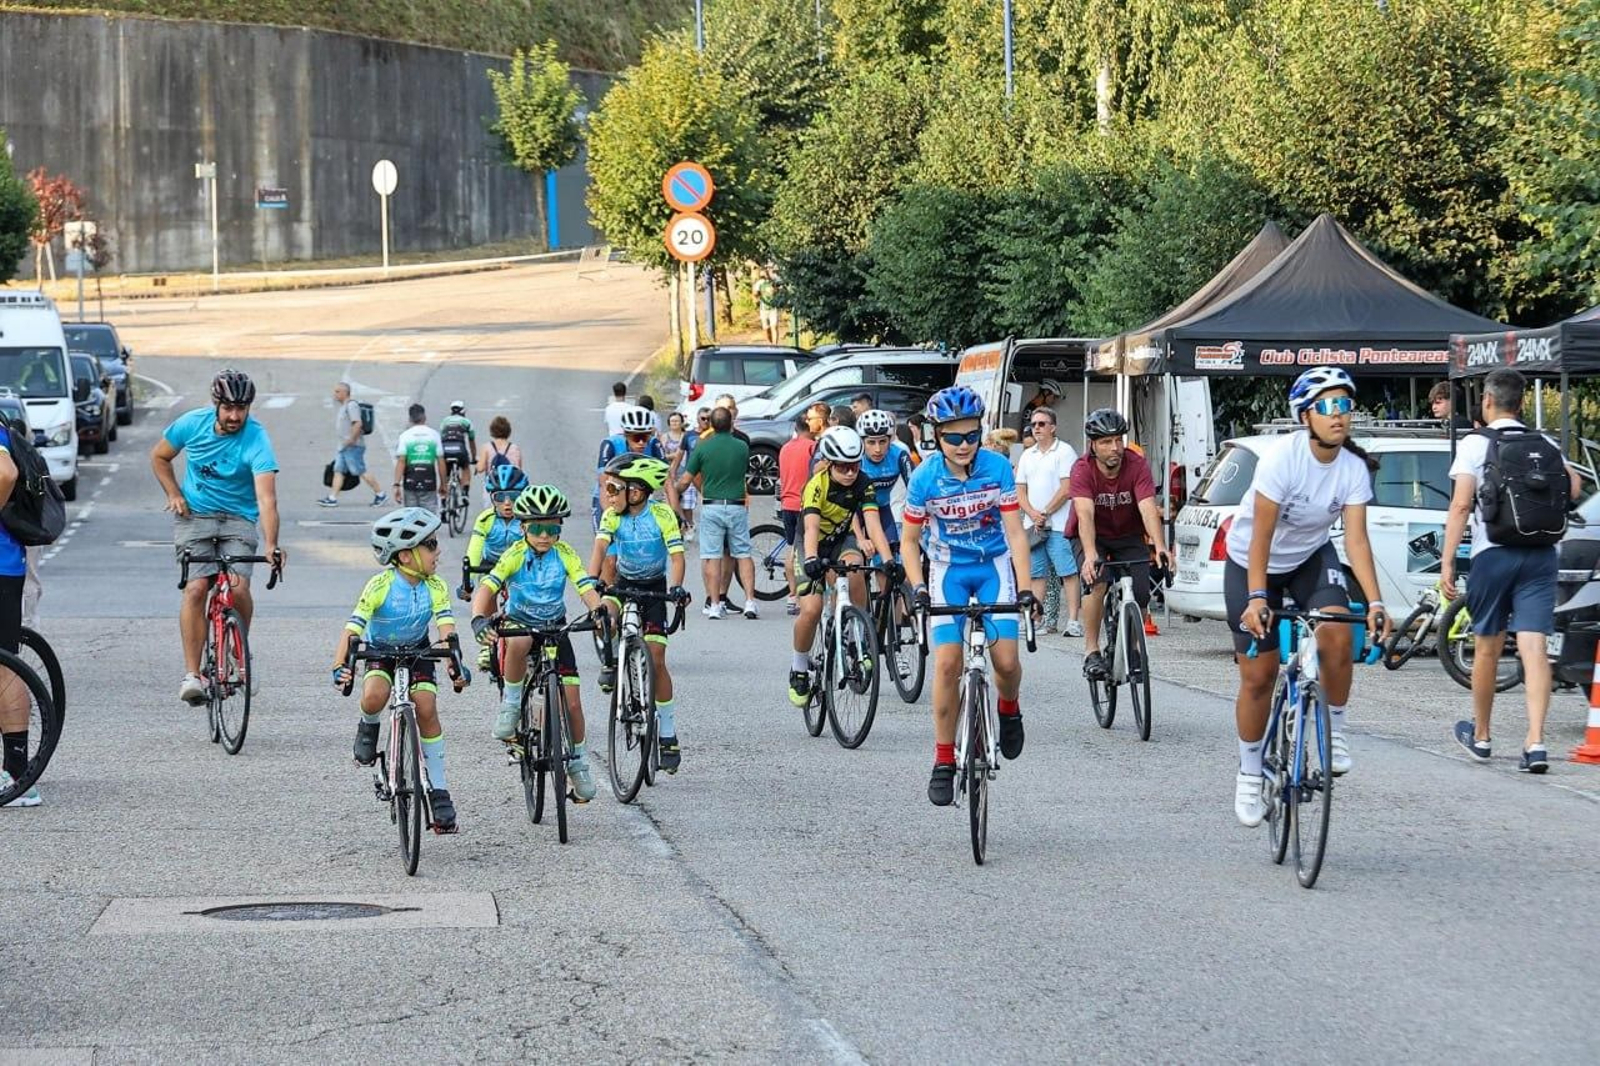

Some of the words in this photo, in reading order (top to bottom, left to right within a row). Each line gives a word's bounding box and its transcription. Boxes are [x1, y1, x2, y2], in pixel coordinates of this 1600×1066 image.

[677, 229, 704, 246] 20
[1260, 349, 1295, 365] Club
[1298, 348, 1356, 364] Ciclista
[940, 500, 994, 519] Vigués
